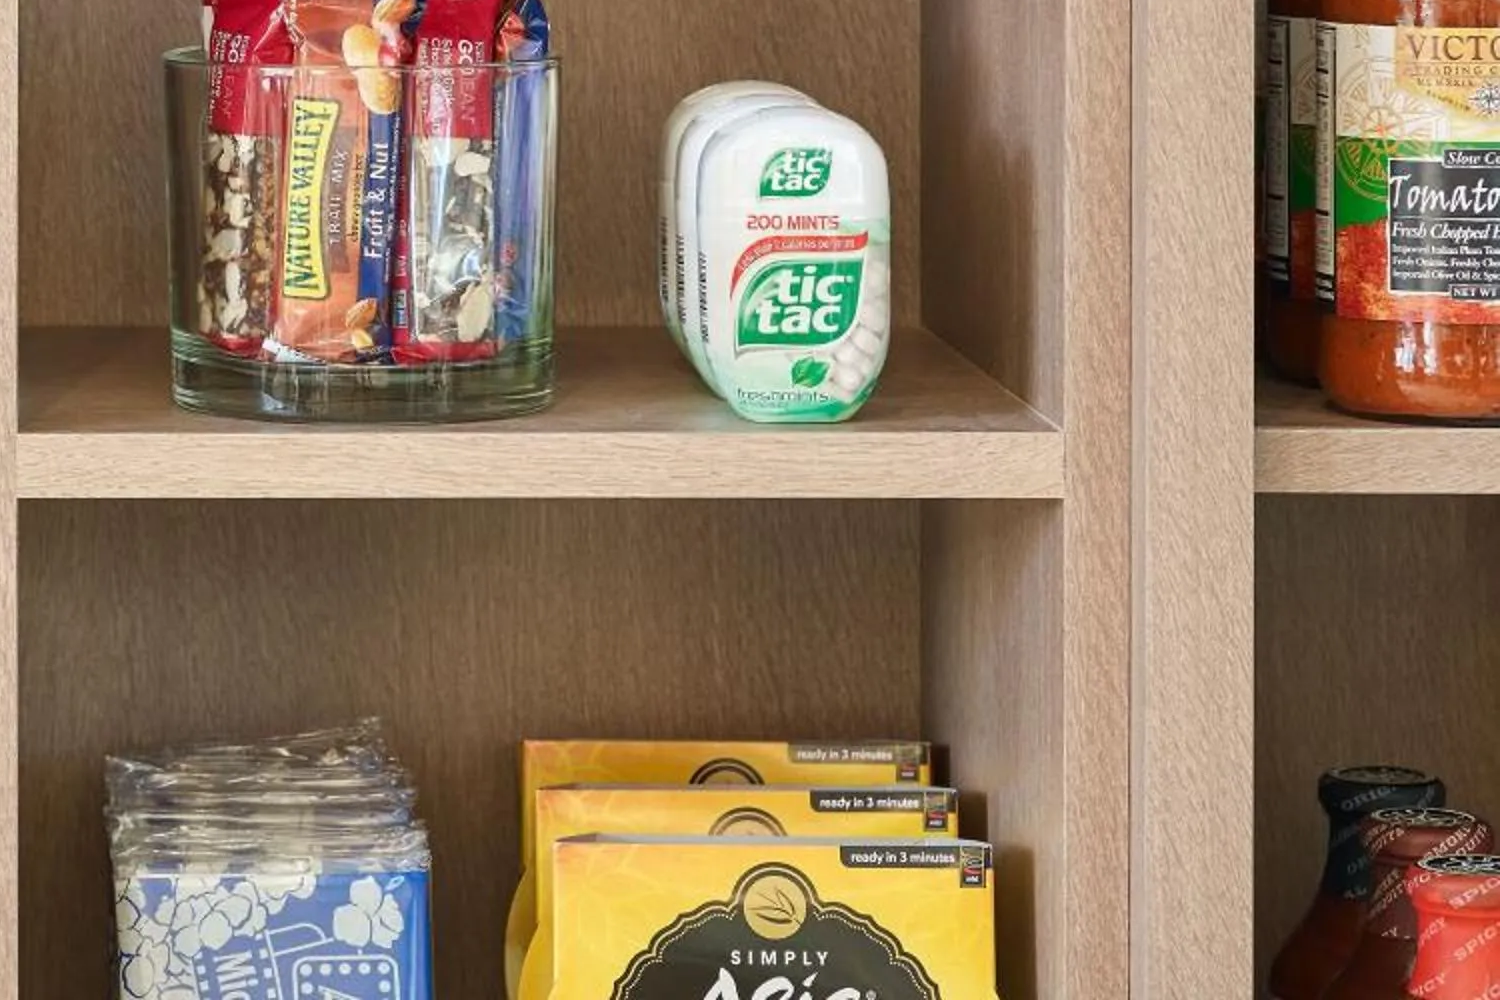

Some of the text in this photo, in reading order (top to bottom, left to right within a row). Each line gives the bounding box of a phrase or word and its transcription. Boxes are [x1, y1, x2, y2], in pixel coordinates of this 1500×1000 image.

[784, 150, 824, 173] tic
[1447, 152, 1481, 165] Slow
[770, 170, 821, 191] tac
[284, 106, 331, 290] NATURE VALLEY
[364, 142, 389, 258] Fruit & Nut
[1390, 174, 1500, 214] Tomato
[746, 214, 841, 231] 200 MINTS
[1392, 221, 1491, 243] Fresh Chopped
[776, 265, 843, 305] tic
[755, 302, 841, 335] tac
[842, 749, 849, 760] 3
[851, 750, 893, 760] minutes
[819, 797, 920, 812] ready in 3 minutes
[851, 851, 956, 865] ready in 3 minutes
[1448, 877, 1500, 909] SPIC
[1419, 916, 1447, 946] PICY
[1454, 921, 1500, 961] SPIC
[731, 950, 828, 966] SIMPLY
